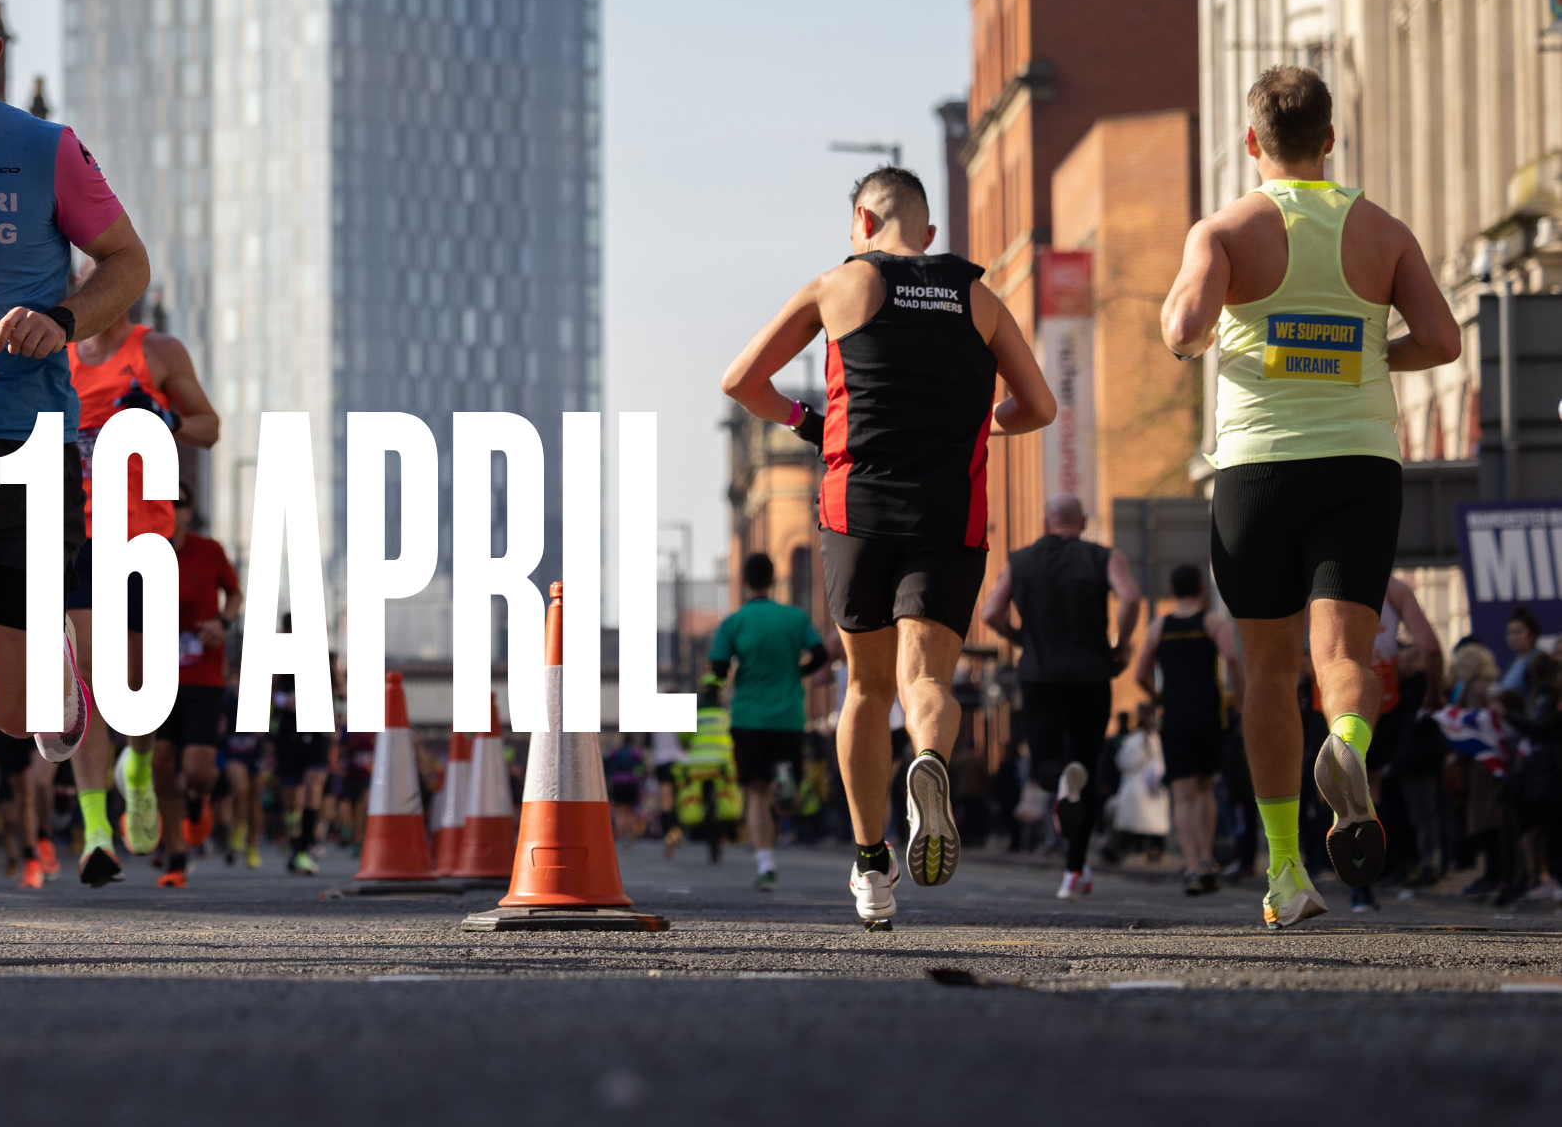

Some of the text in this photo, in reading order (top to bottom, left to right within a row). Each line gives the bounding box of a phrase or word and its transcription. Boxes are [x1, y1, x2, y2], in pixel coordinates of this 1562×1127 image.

[896, 285, 958, 301] PHOENIX
[894, 297, 963, 314] ROAD RUNNERS
[1275, 322, 1356, 343] WE SUPPORT
[1286, 355, 1341, 375] UKRAINE
